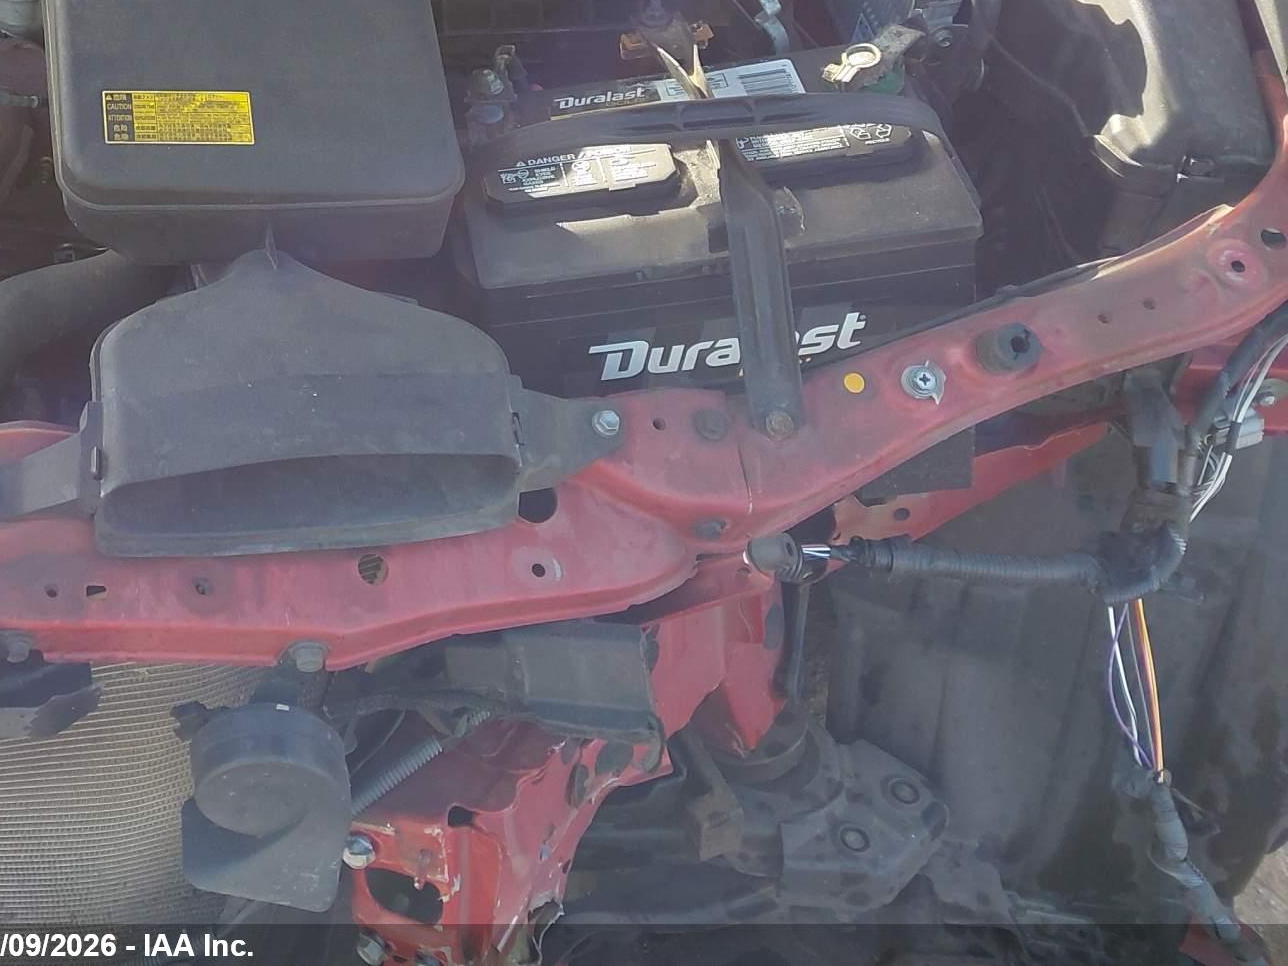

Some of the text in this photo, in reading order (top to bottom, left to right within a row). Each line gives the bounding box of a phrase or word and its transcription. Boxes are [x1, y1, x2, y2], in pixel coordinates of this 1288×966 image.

[554, 87, 646, 109] Duralast
[528, 153, 576, 166] DANGER
[588, 312, 867, 380] Durast
